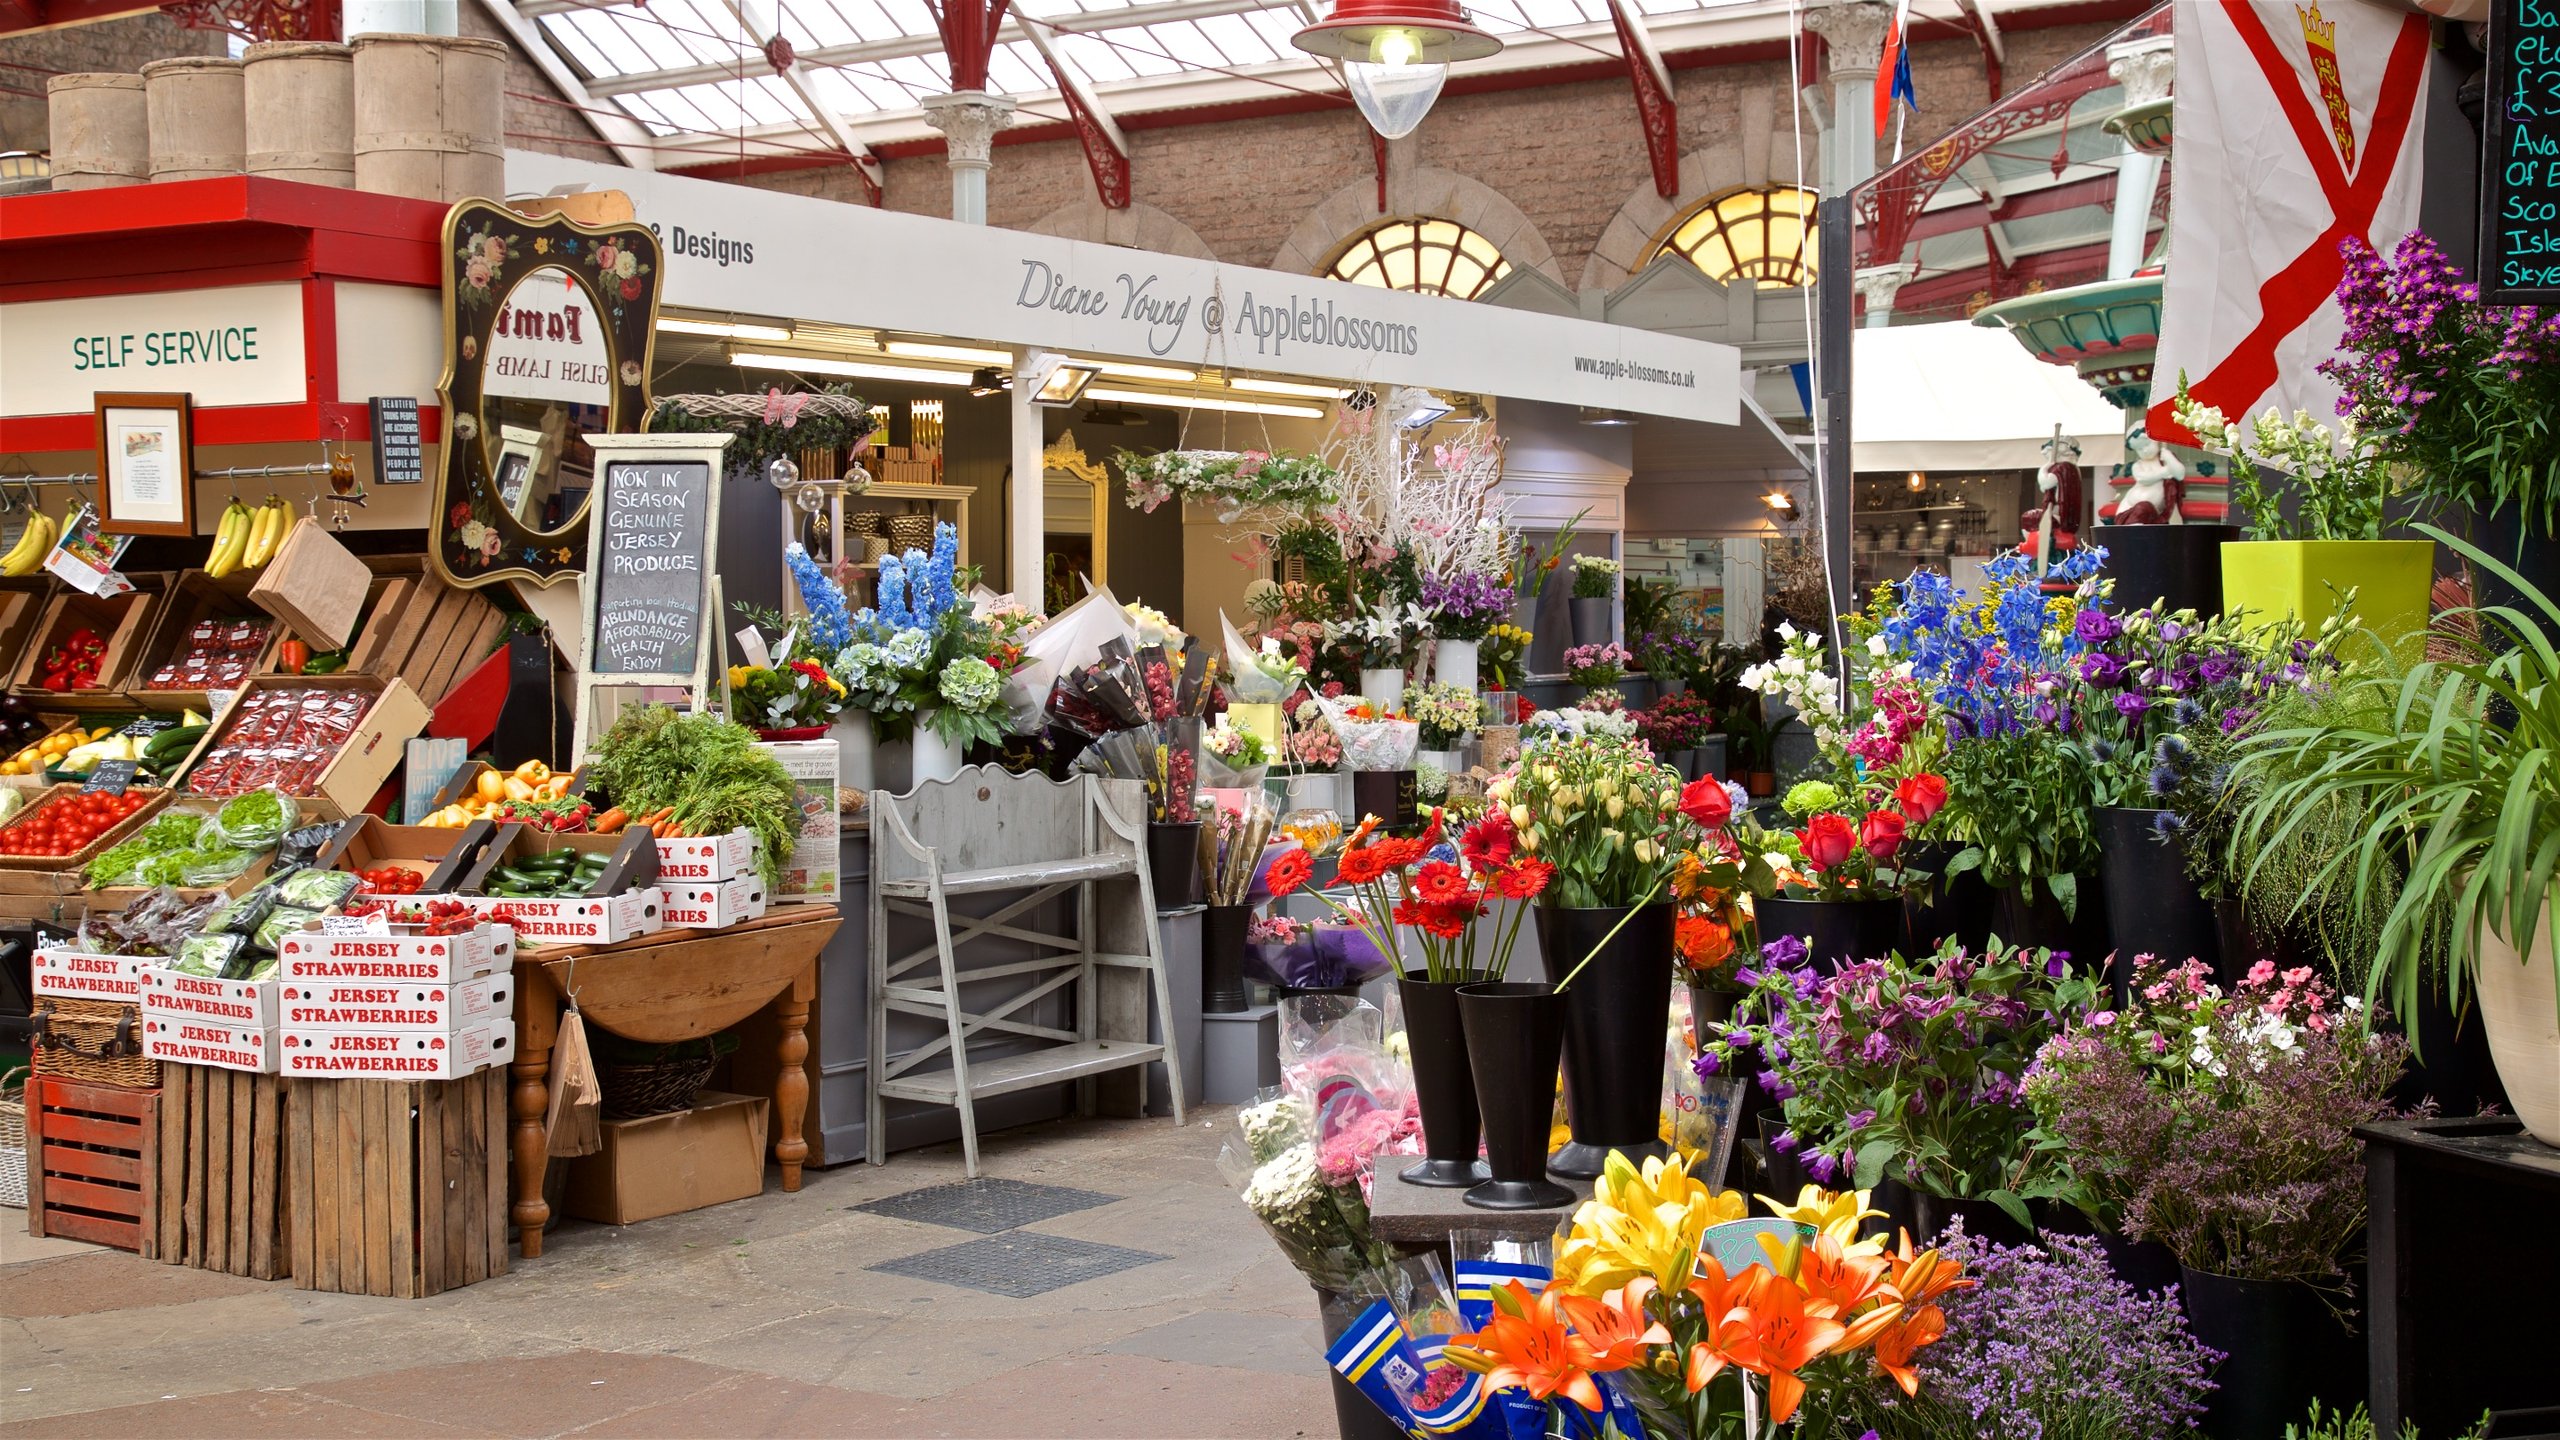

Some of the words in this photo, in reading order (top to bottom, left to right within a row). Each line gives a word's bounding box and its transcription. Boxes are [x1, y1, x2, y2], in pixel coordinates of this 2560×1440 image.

[2512, 124, 2559, 157] Ava
[2506, 161, 2539, 186] Of
[2502, 195, 2556, 221] Sco
[673, 226, 754, 267] Designs
[2503, 260, 2560, 287] Skye
[1017, 259, 1108, 316] Diane
[1117, 273, 1192, 356] Young
[1201, 296, 1225, 334] @
[1235, 291, 1418, 357] Appleblossoms
[73, 335, 135, 370] SELF
[145, 327, 259, 367] SERVICE
[1574, 356, 1696, 388] www.apple-blossoms.co.uk
[382, 399, 416, 409] BEAUTIFUL
[383, 411, 399, 420] YOUNG
[400, 411, 417, 420] PEOPLE
[384, 423, 394, 432] ARE
[394, 423, 418, 432] ACCIDENTS
[385, 435, 391, 444] OF
[410, 435, 418, 444] BUT
[386, 447, 410, 456] BEAUTIFUL
[410, 447, 420, 456] OLD
[386, 459, 408, 469] PEOPLE
[410, 459, 421, 468] ARE
[387, 471, 404, 480] WORKS
[404, 471, 410, 480] OF
[614, 467, 650, 488] NOW
[662, 471, 680, 488] IN
[614, 490, 690, 508] SEASON
[609, 510, 684, 529] GENUINE
[610, 531, 682, 550] JERSEY
[614, 555, 698, 576] PRODUCE
[601, 609, 689, 630] ABUNDANCE
[604, 625, 691, 646] AFFORDABILITY
[611, 640, 664, 658] HEALTH
[622, 656, 662, 672] ENJOY!
[414, 741, 461, 769] LIVE
[412, 775, 441, 795] WITH
[330, 943, 400, 957] JERSEY
[68, 959, 119, 974] JERSEY
[292, 962, 439, 978] STRAWBERRIES
[174, 978, 223, 996] JERSEY
[329, 989, 400, 1002] JERSEY
[147, 993, 253, 1019] STRAWBERRIES
[291, 1008, 438, 1024] STRAWBERRIES
[180, 1026, 231, 1043] JERSEY
[330, 1037, 400, 1051] JERSEY
[152, 1041, 258, 1067] STRAWBERRIES
[292, 1056, 438, 1071] STRAWBERRIES
[1707, 1221, 1765, 1240] REDUCED
[1509, 1402, 1534, 1410] PRODUCT
